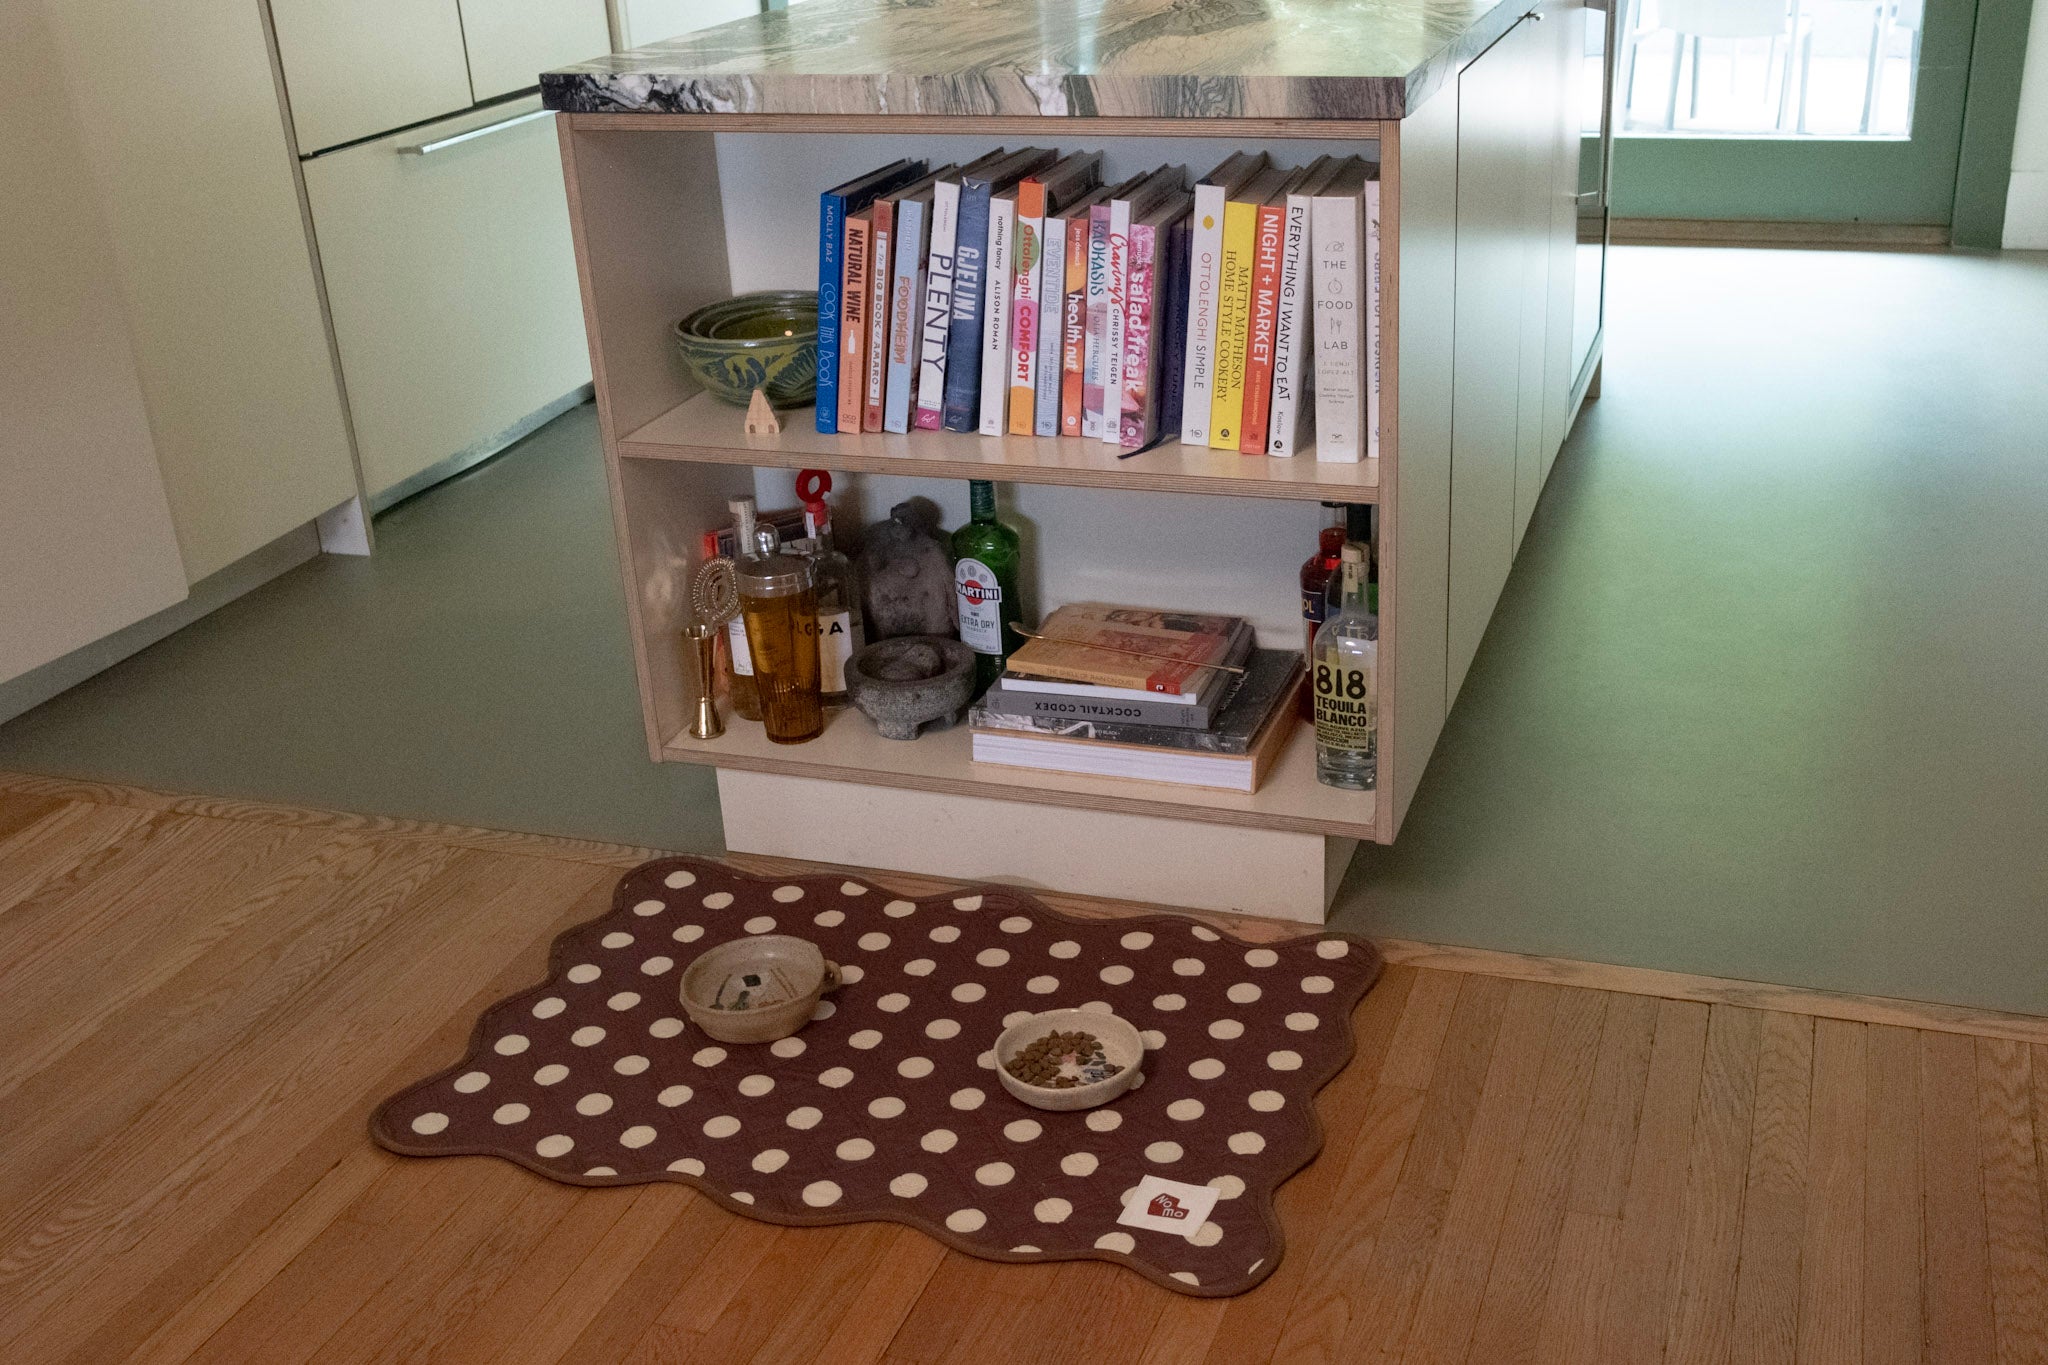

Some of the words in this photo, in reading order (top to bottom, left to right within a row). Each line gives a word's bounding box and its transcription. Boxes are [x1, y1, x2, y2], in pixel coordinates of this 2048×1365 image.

[826, 205, 834, 239] MOLLY
[995, 215, 1003, 246] nothing
[825, 243, 833, 263] BAZ
[847, 228, 864, 285] NATURAL
[994, 247, 1002, 270] fancy
[1019, 224, 1035, 299] Ottolenghi
[1090, 220, 1106, 296] KAUKASIS
[1260, 214, 1279, 273] NIGHT
[1283, 206, 1304, 298] EVERYTHING
[876, 269, 884, 290] BIG
[953, 245, 980, 320] GJELINA
[1044, 237, 1062, 314] EVENTIDE
[1107, 233, 1129, 309] Cravings
[1224, 250, 1237, 292] HOME
[1322, 260, 1347, 270] THE
[845, 290, 862, 324] WINE
[993, 280, 1001, 314] ALISON
[1127, 272, 1148, 331] salad
[1196, 252, 1212, 341] OTTOLENGHI
[1236, 266, 1249, 314] MATTY
[1317, 300, 1353, 310] FOOD
[874, 294, 883, 328] BOOK
[894, 275, 912, 365] FOODHEIM
[922, 253, 953, 373] PLENTY
[1066, 293, 1083, 344] health
[1111, 308, 1120, 349] CHRISSY
[1221, 295, 1234, 337] STYLE
[1253, 289, 1273, 366] MARKET
[820, 326, 835, 344] THIS
[992, 317, 1000, 351] ROMAN
[1017, 305, 1032, 382] COMFORT
[1278, 310, 1293, 353] WANT
[1323, 341, 1348, 350] LAB
[871, 341, 881, 386] AMARO
[1065, 346, 1079, 370] nut
[1091, 337, 1100, 381] HERCULES
[1110, 352, 1118, 385] TEIGEN
[1125, 334, 1146, 391] freak
[1193, 344, 1207, 389] SIMPLE
[1216, 340, 1231, 403] COOKERY
[1231, 316, 1246, 390] MATHESON
[1276, 355, 1288, 373] TO
[1276, 377, 1291, 401] EAT
[1276, 411, 1284, 435] Koslow
[956, 582, 998, 600] MARTINI
[1302, 598, 1315, 614] OL
[960, 614, 981, 627] EXTRA
[980, 619, 995, 629] DRY
[1316, 664, 1366, 700] 818
[1035, 701, 1076, 714] CODEX
[1079, 704, 1142, 717] COCKTAIL
[1316, 695, 1367, 715] TEQUILA
[1316, 708, 1367, 727] BLANCO
